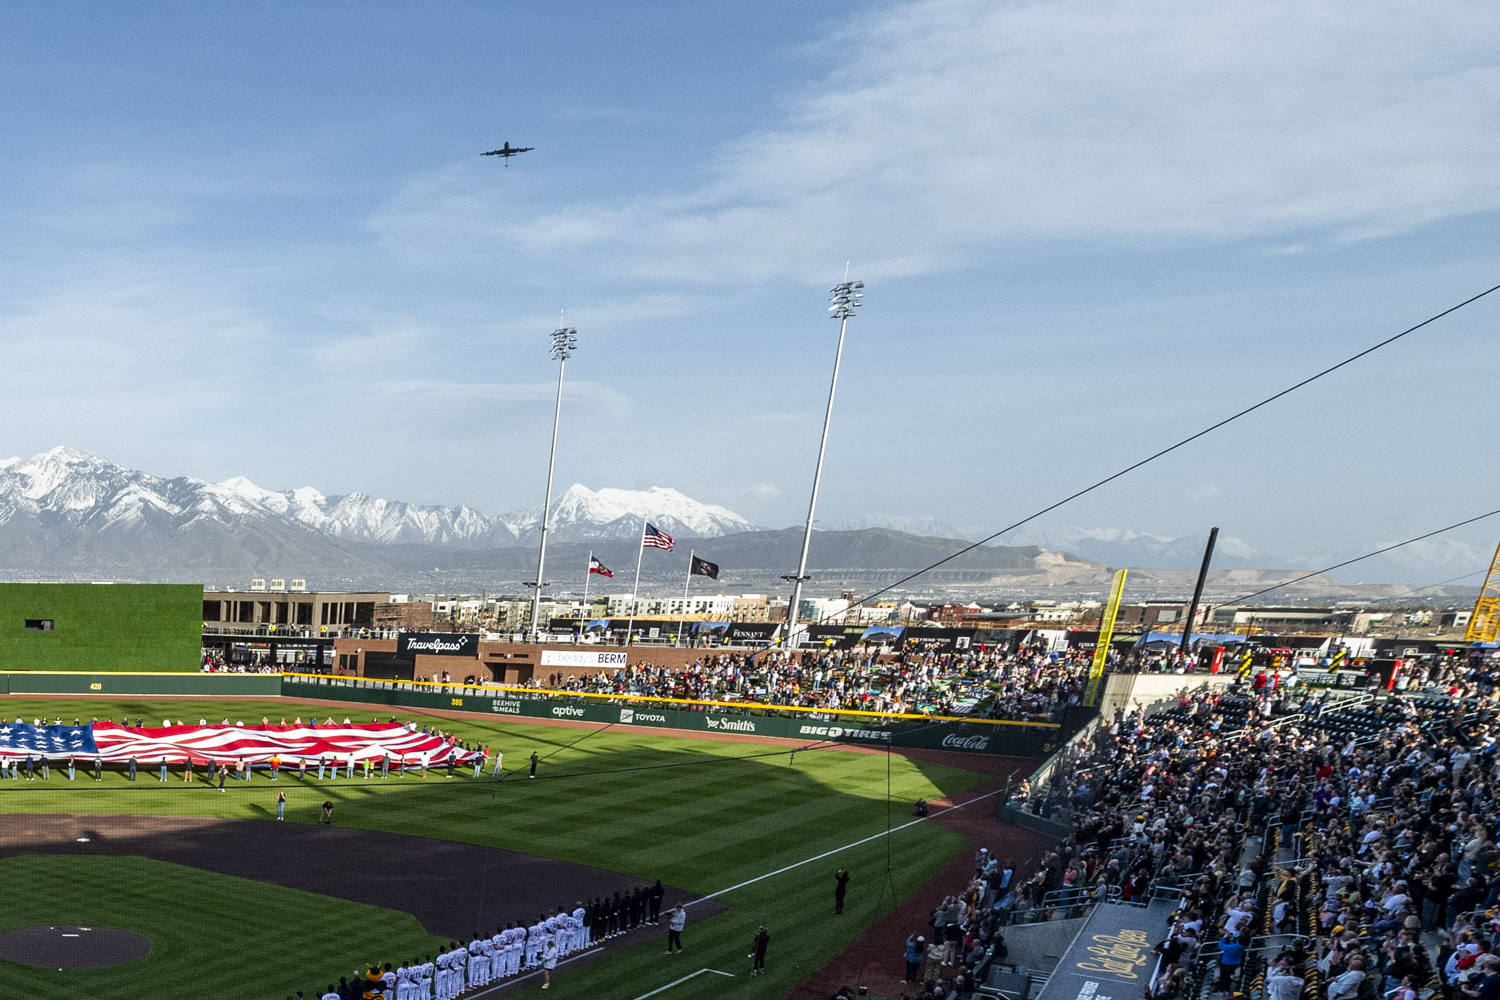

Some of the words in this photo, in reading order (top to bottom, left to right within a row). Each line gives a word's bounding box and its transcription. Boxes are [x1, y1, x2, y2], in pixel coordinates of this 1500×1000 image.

[407, 638, 460, 653] Travelpass
[598, 653, 626, 664] BERM
[492, 699, 521, 708] BEEHIVE
[499, 706, 520, 714] MEALS
[552, 705, 584, 718] aptive
[635, 713, 666, 722] TOYOTA
[720, 717, 756, 732] Smith's
[799, 725, 828, 736] BIG
[844, 728, 892, 740] TIRES
